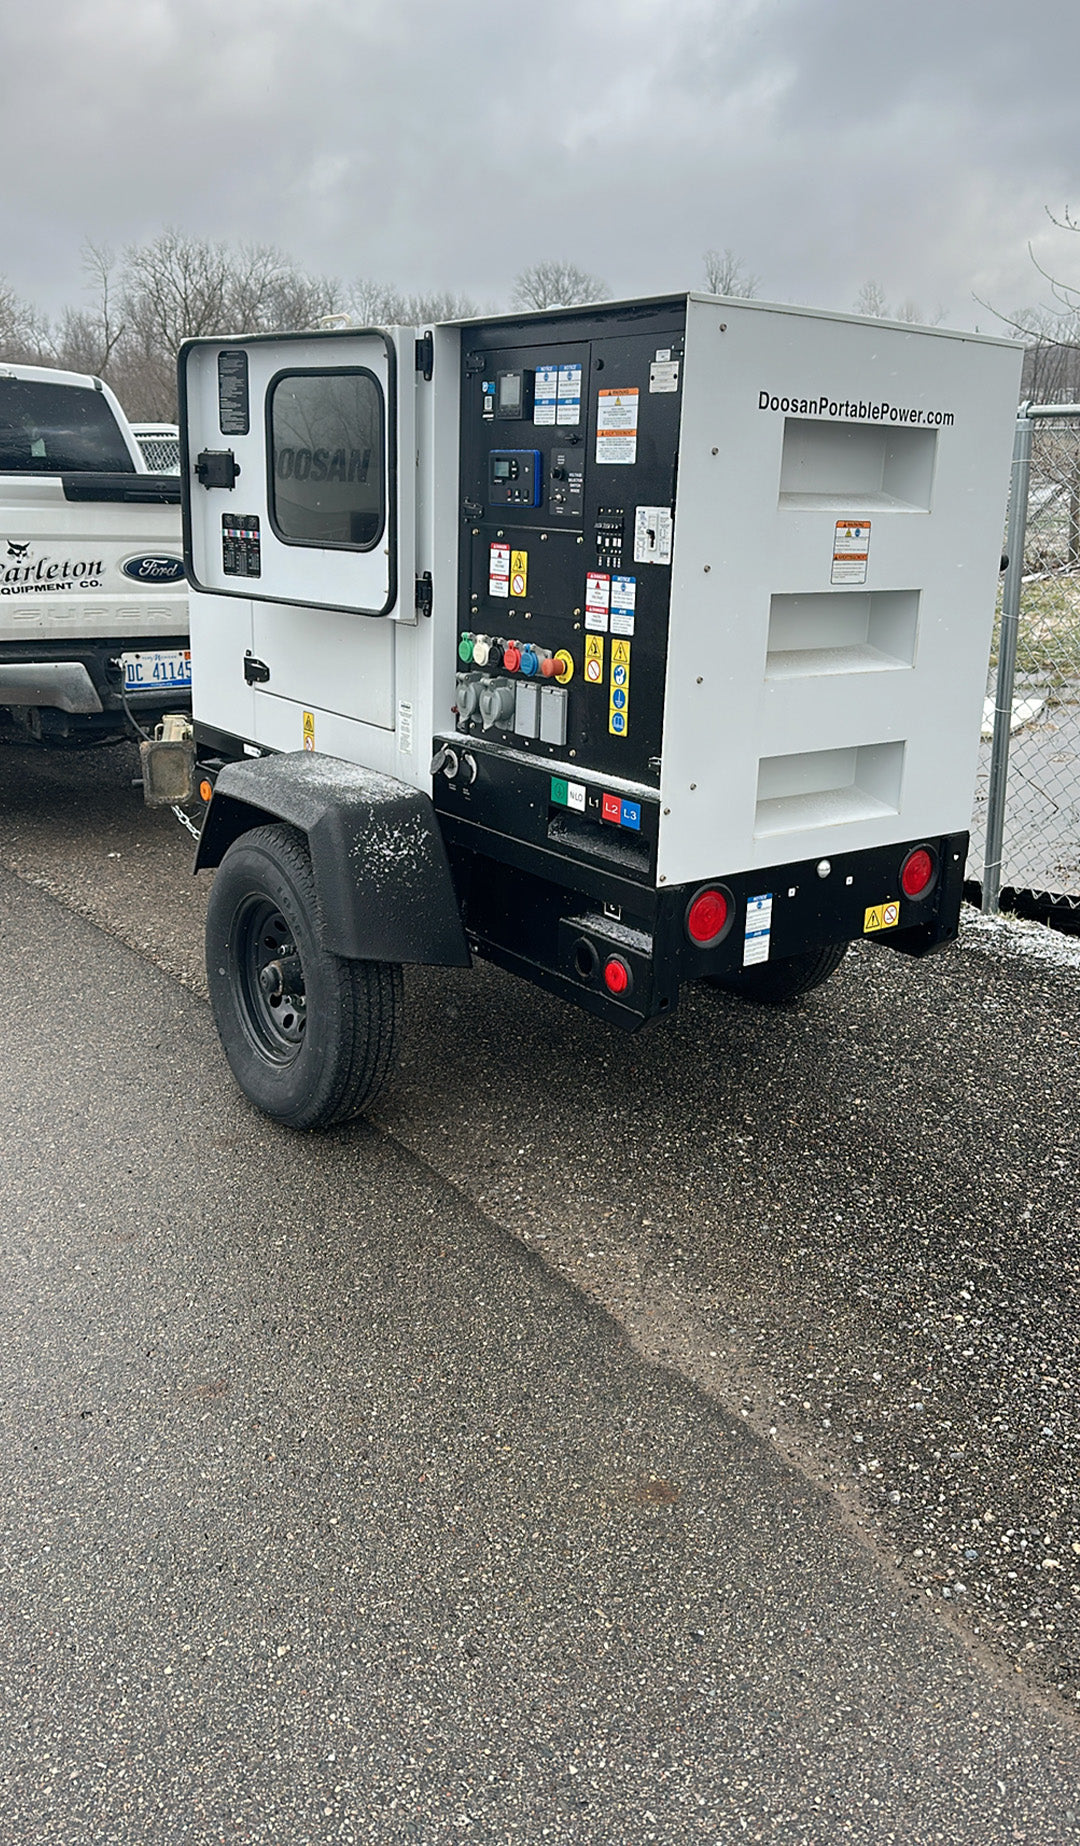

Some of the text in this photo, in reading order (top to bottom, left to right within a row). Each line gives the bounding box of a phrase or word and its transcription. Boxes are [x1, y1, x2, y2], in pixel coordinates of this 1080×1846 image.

[758, 391, 955, 426] DoosanPortablePower.com
[274, 447, 372, 482] OOSAN
[138, 559, 178, 577] Ford
[0, 580, 103, 595] QUIPMENT CO.
[13, 607, 173, 621] SUPER
[127, 663, 144, 682] DC
[588, 796, 600, 808] L1
[605, 802, 619, 815] L2
[623, 808, 637, 821] L3
